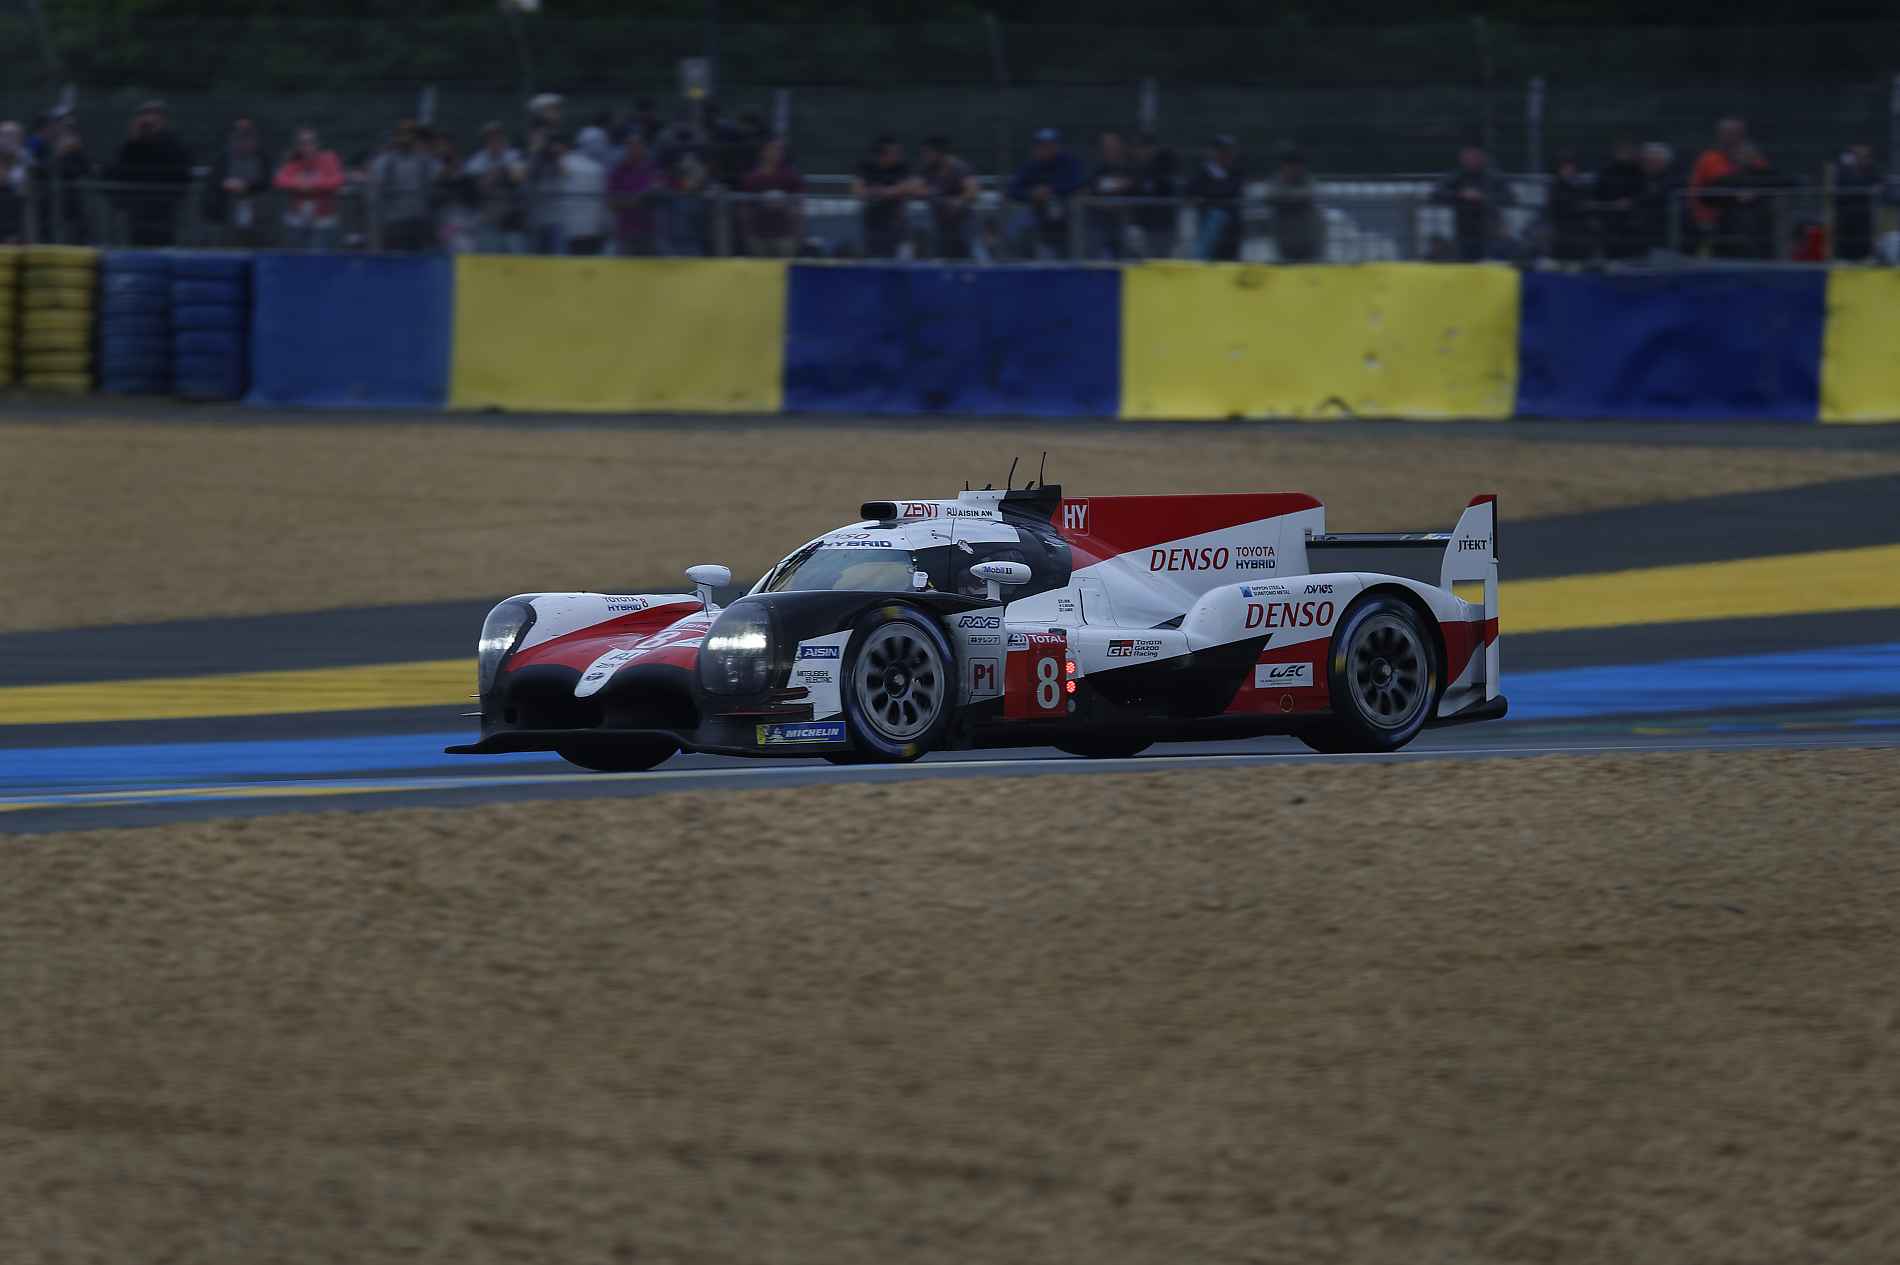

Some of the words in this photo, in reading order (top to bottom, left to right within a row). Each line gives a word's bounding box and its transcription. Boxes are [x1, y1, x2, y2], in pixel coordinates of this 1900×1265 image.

[901, 503, 940, 517] ZENT
[1063, 504, 1088, 529] HY
[1235, 546, 1275, 557] TOYOTA
[1458, 539, 1488, 552] JTEKT
[1149, 547, 1229, 572] DENSO
[1235, 559, 1276, 569] HYBRID
[983, 566, 1004, 574] Mobil
[1245, 601, 1334, 629] DENSO
[959, 616, 1000, 628] RAYS
[1027, 634, 1065, 644] TOTAL
[803, 648, 838, 657] AISIN
[1107, 646, 1132, 656] GR
[974, 663, 994, 689] P1
[1270, 665, 1305, 677] WEC
[1036, 656, 1061, 710] 8
[785, 728, 840, 737] MICHELIN
